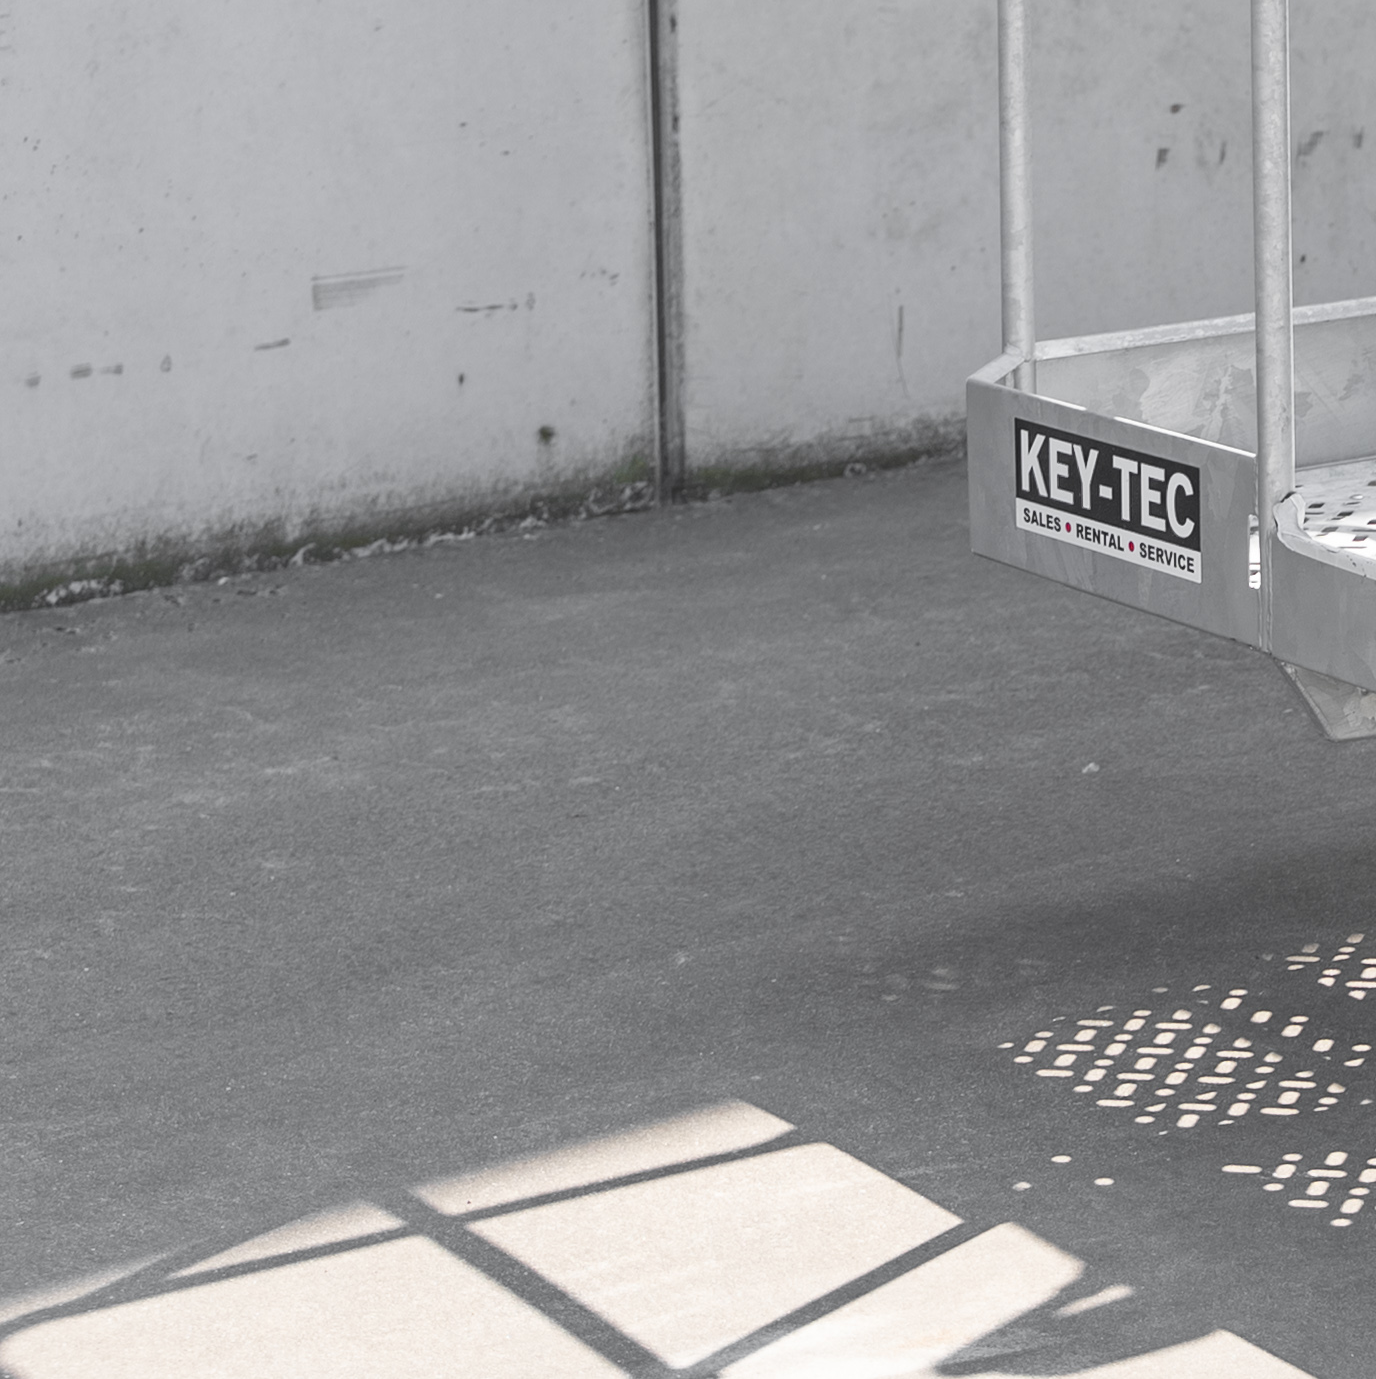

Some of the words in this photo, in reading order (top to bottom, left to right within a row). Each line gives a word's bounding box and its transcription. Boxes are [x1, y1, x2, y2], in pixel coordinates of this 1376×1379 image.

[1020, 429, 1195, 539] KEY-TEC
[1023, 507, 1062, 533] SALES
[1076, 522, 1125, 553] RENTAL
[1139, 541, 1195, 574] SERVICE
